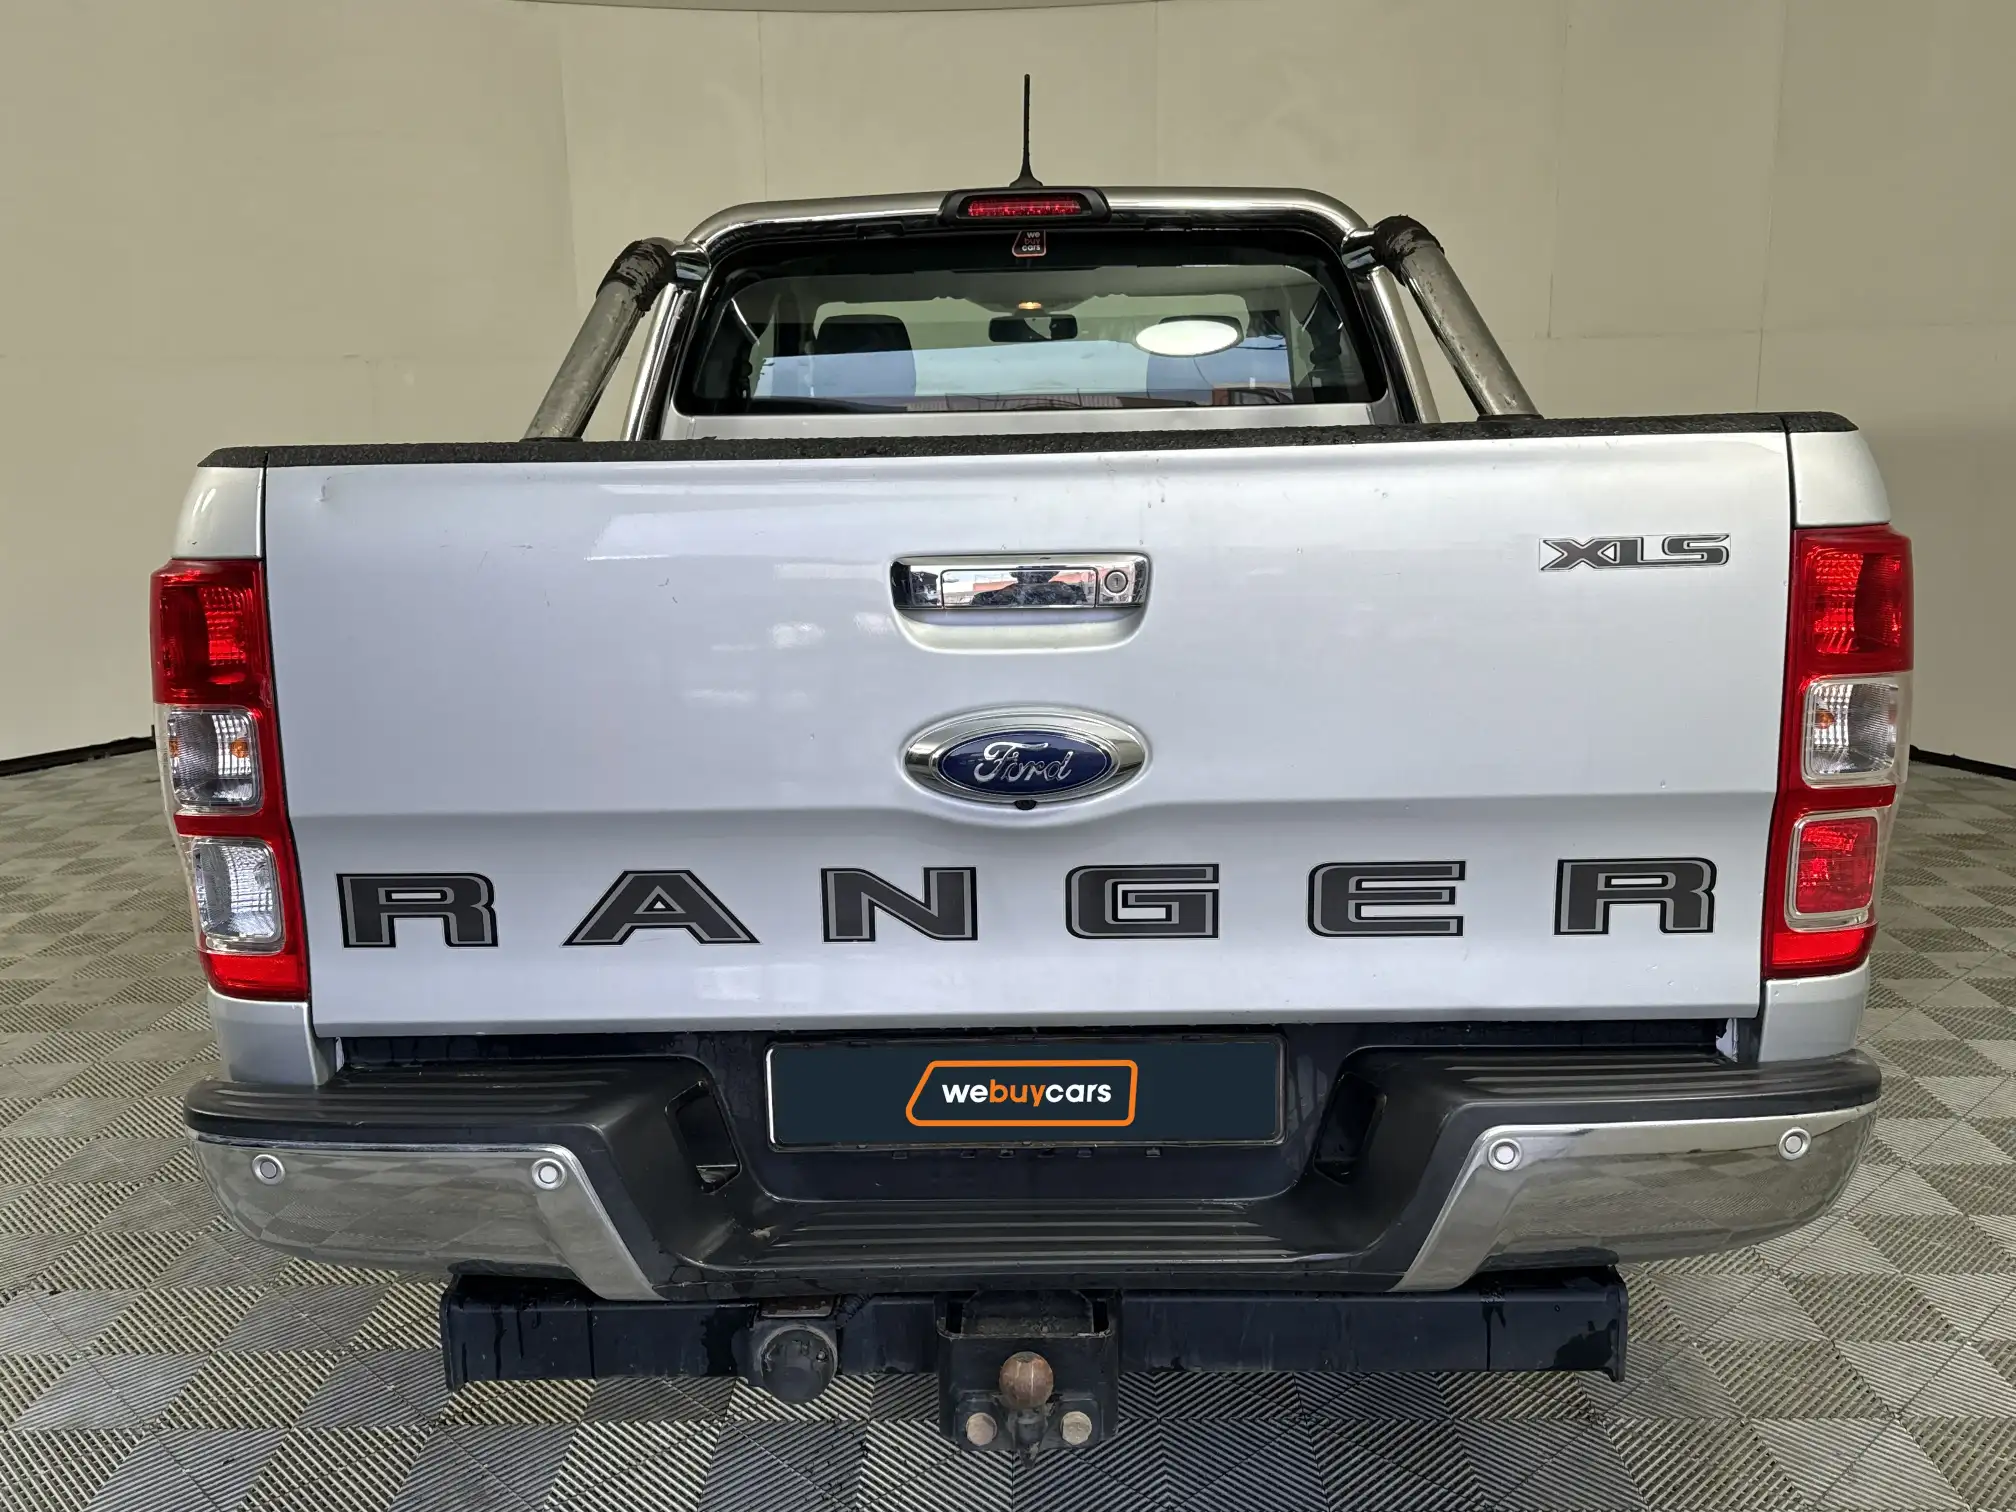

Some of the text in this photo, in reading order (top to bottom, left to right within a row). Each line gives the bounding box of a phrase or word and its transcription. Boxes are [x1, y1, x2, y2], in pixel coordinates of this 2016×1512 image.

[1021, 244, 1041, 252] cars
[1026, 231, 1041, 239] we
[1540, 534, 1730, 571] XLS
[973, 741, 1074, 782] Ford
[336, 857, 1717, 948] RANGER
